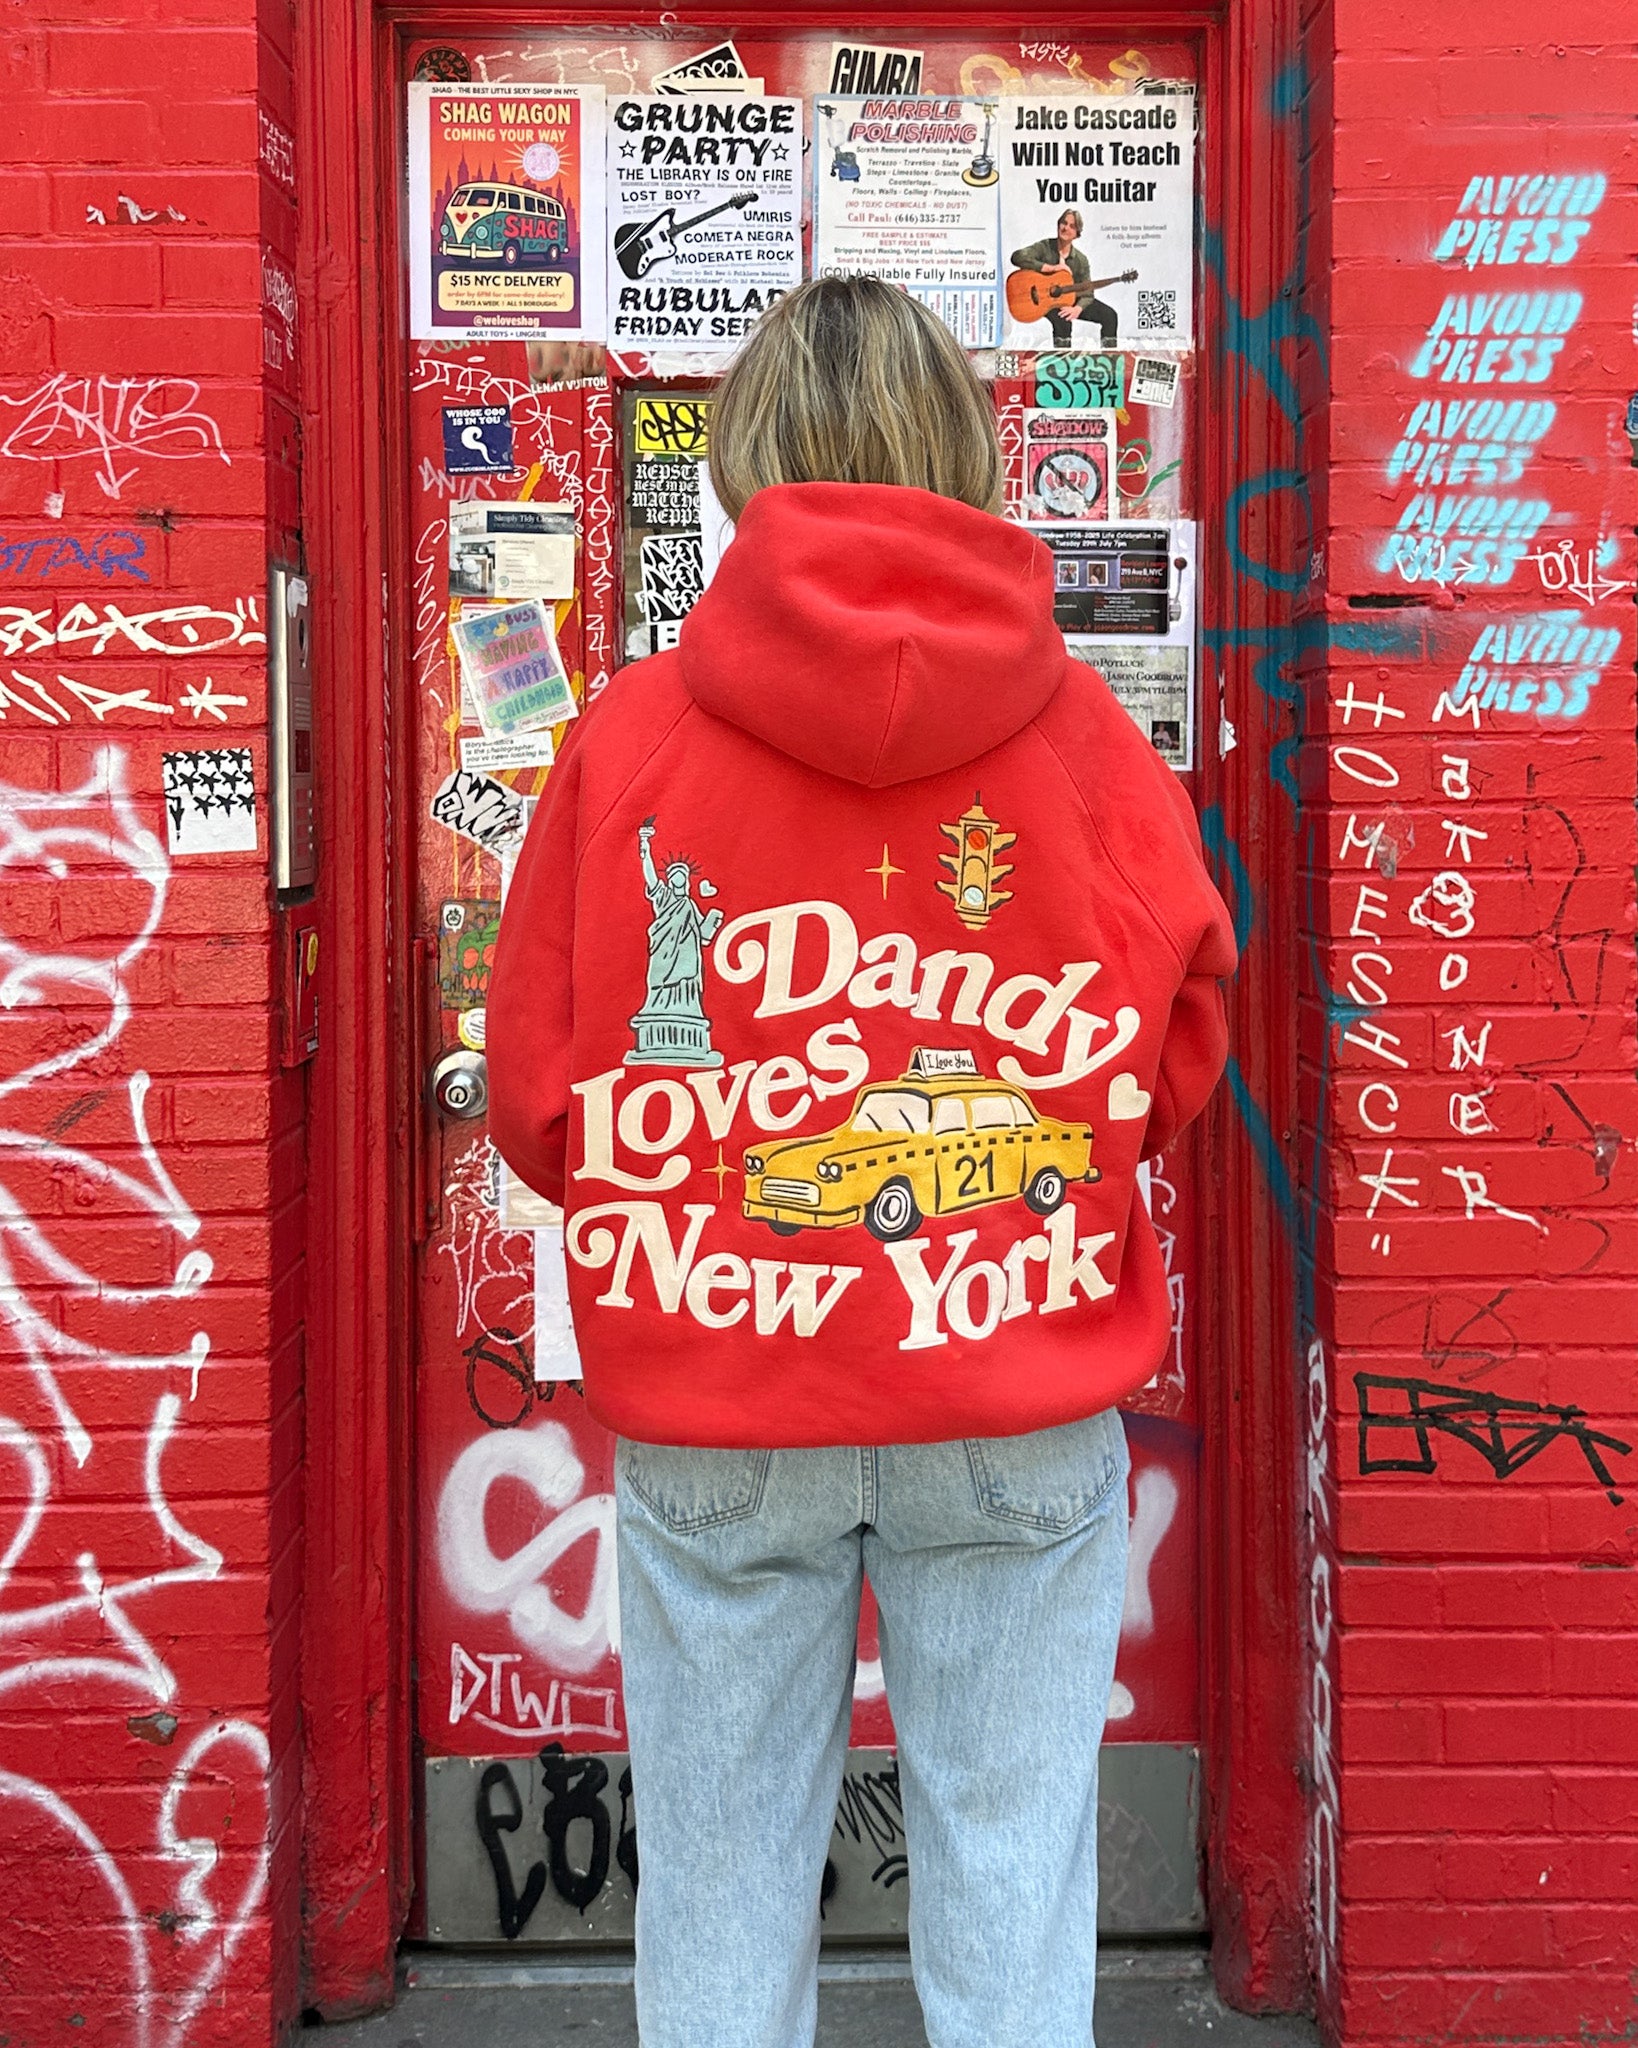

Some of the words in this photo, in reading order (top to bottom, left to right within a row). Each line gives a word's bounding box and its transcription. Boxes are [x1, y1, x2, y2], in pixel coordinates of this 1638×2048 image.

[440, 102, 492, 123] SHAG
[498, 103, 571, 124] WAGON
[614, 101, 795, 133] GRUNGE
[861, 100, 964, 120] MARBLE
[1015, 106, 1068, 130] Jake
[1074, 105, 1177, 130] Cascade
[444, 128, 495, 141] COMING
[499, 129, 534, 141] YOUR
[538, 129, 566, 142] WAY
[847, 122, 978, 144] POLISHING
[641, 135, 773, 166] PARTY
[921, 147, 950, 155] Polishing
[1012, 142, 1059, 166] Will
[1065, 142, 1104, 166] Not
[1110, 142, 1181, 166] Teach
[617, 168, 643, 180] THE
[651, 168, 711, 181] LIBRARY
[717, 169, 729, 181] IS
[736, 169, 756, 181] ON
[763, 169, 793, 182] FIRE
[621, 190, 657, 202] LOST
[665, 190, 700, 201] BOY?
[1036, 179, 1078, 203] You
[1084, 178, 1157, 203] Guitar
[1457, 172, 1606, 216] AVOID
[503, 215, 558, 240] SHAG
[743, 211, 792, 222] UMIRIS
[848, 213, 865, 222] Call
[868, 214, 892, 223] Paul:
[684, 231, 743, 243] COMETA
[747, 231, 794, 242] NEGRA
[1435, 219, 1590, 267] PRESS
[675, 250, 751, 265] MODERATE
[757, 250, 794, 261] ROCK
[451, 273, 471, 287] $15
[474, 276, 500, 286] NYC
[504, 276, 562, 287] DELIVERY
[916, 268, 945, 282] Fully
[950, 269, 996, 280] Insured
[473, 315, 540, 328] @weloveshag
[1430, 292, 1582, 337] AVOID
[615, 316, 703, 336] FRIDAY
[1410, 338, 1563, 383] PRESS
[446, 408, 483, 418] WHOSE
[479, 417, 500, 425] YOU
[1402, 399, 1556, 442] AVOID
[1387, 441, 1534, 486] PRESS
[634, 480, 664, 491] REST
[494, 514, 518, 523] Simply
[520, 515, 536, 523] Tidy
[1398, 494, 1550, 537] AVOID
[1055, 540, 1080, 548] Tuesday
[1116, 532, 1151, 540] Celebration
[1469, 622, 1620, 664] AVOID
[1100, 658, 1144, 667] POTLUCK
[503, 658, 547, 690] HAPPY
[1454, 662, 1600, 718] PRESS
[713, 899, 1141, 1088] Dandy
[926, 1054, 933, 1068] I
[935, 1054, 953, 1070] Love
[954, 1054, 974, 1068] You
[570, 1017, 870, 1191] Loves
[955, 1150, 994, 1197] 21
[565, 1201, 862, 1338] New
[884, 1203, 1119, 1351] York
